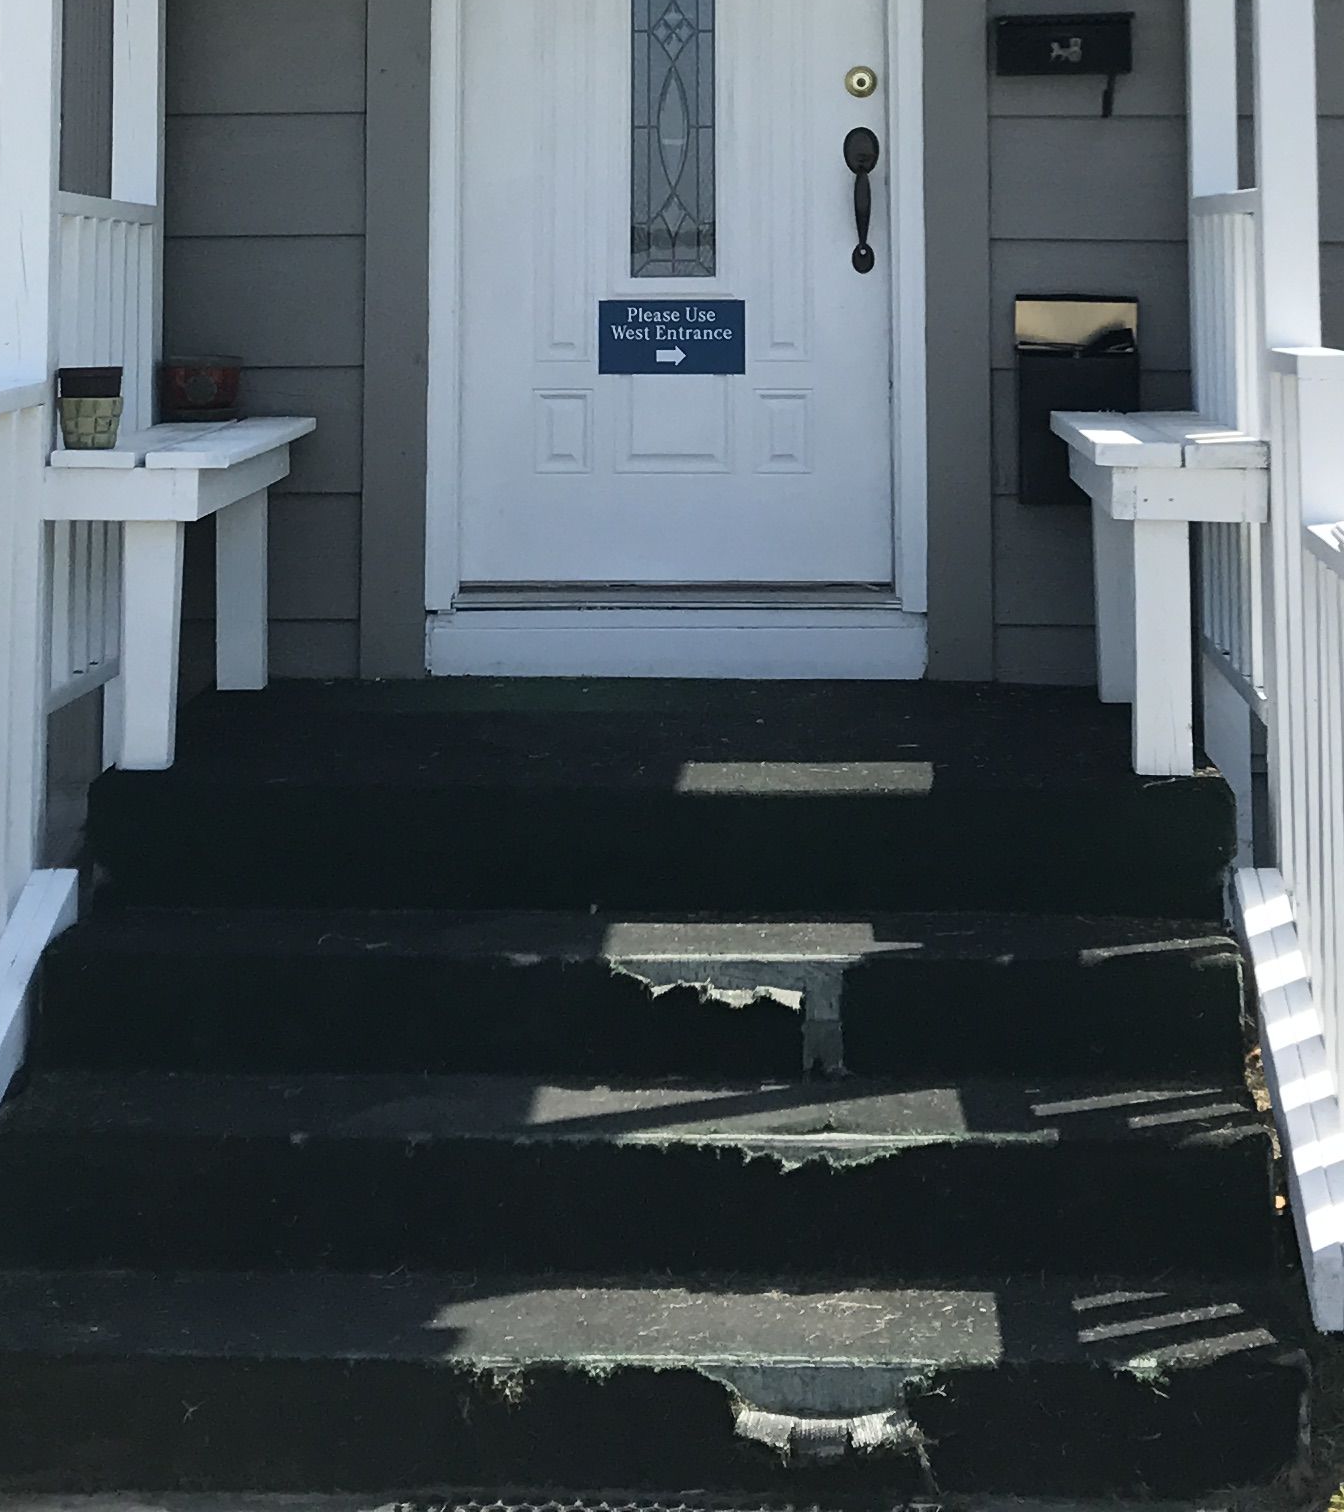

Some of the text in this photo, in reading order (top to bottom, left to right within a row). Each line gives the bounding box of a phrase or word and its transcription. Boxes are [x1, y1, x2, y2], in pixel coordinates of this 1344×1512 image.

[627, 306, 716, 323] Please Use
[611, 324, 733, 341] West Entrance
